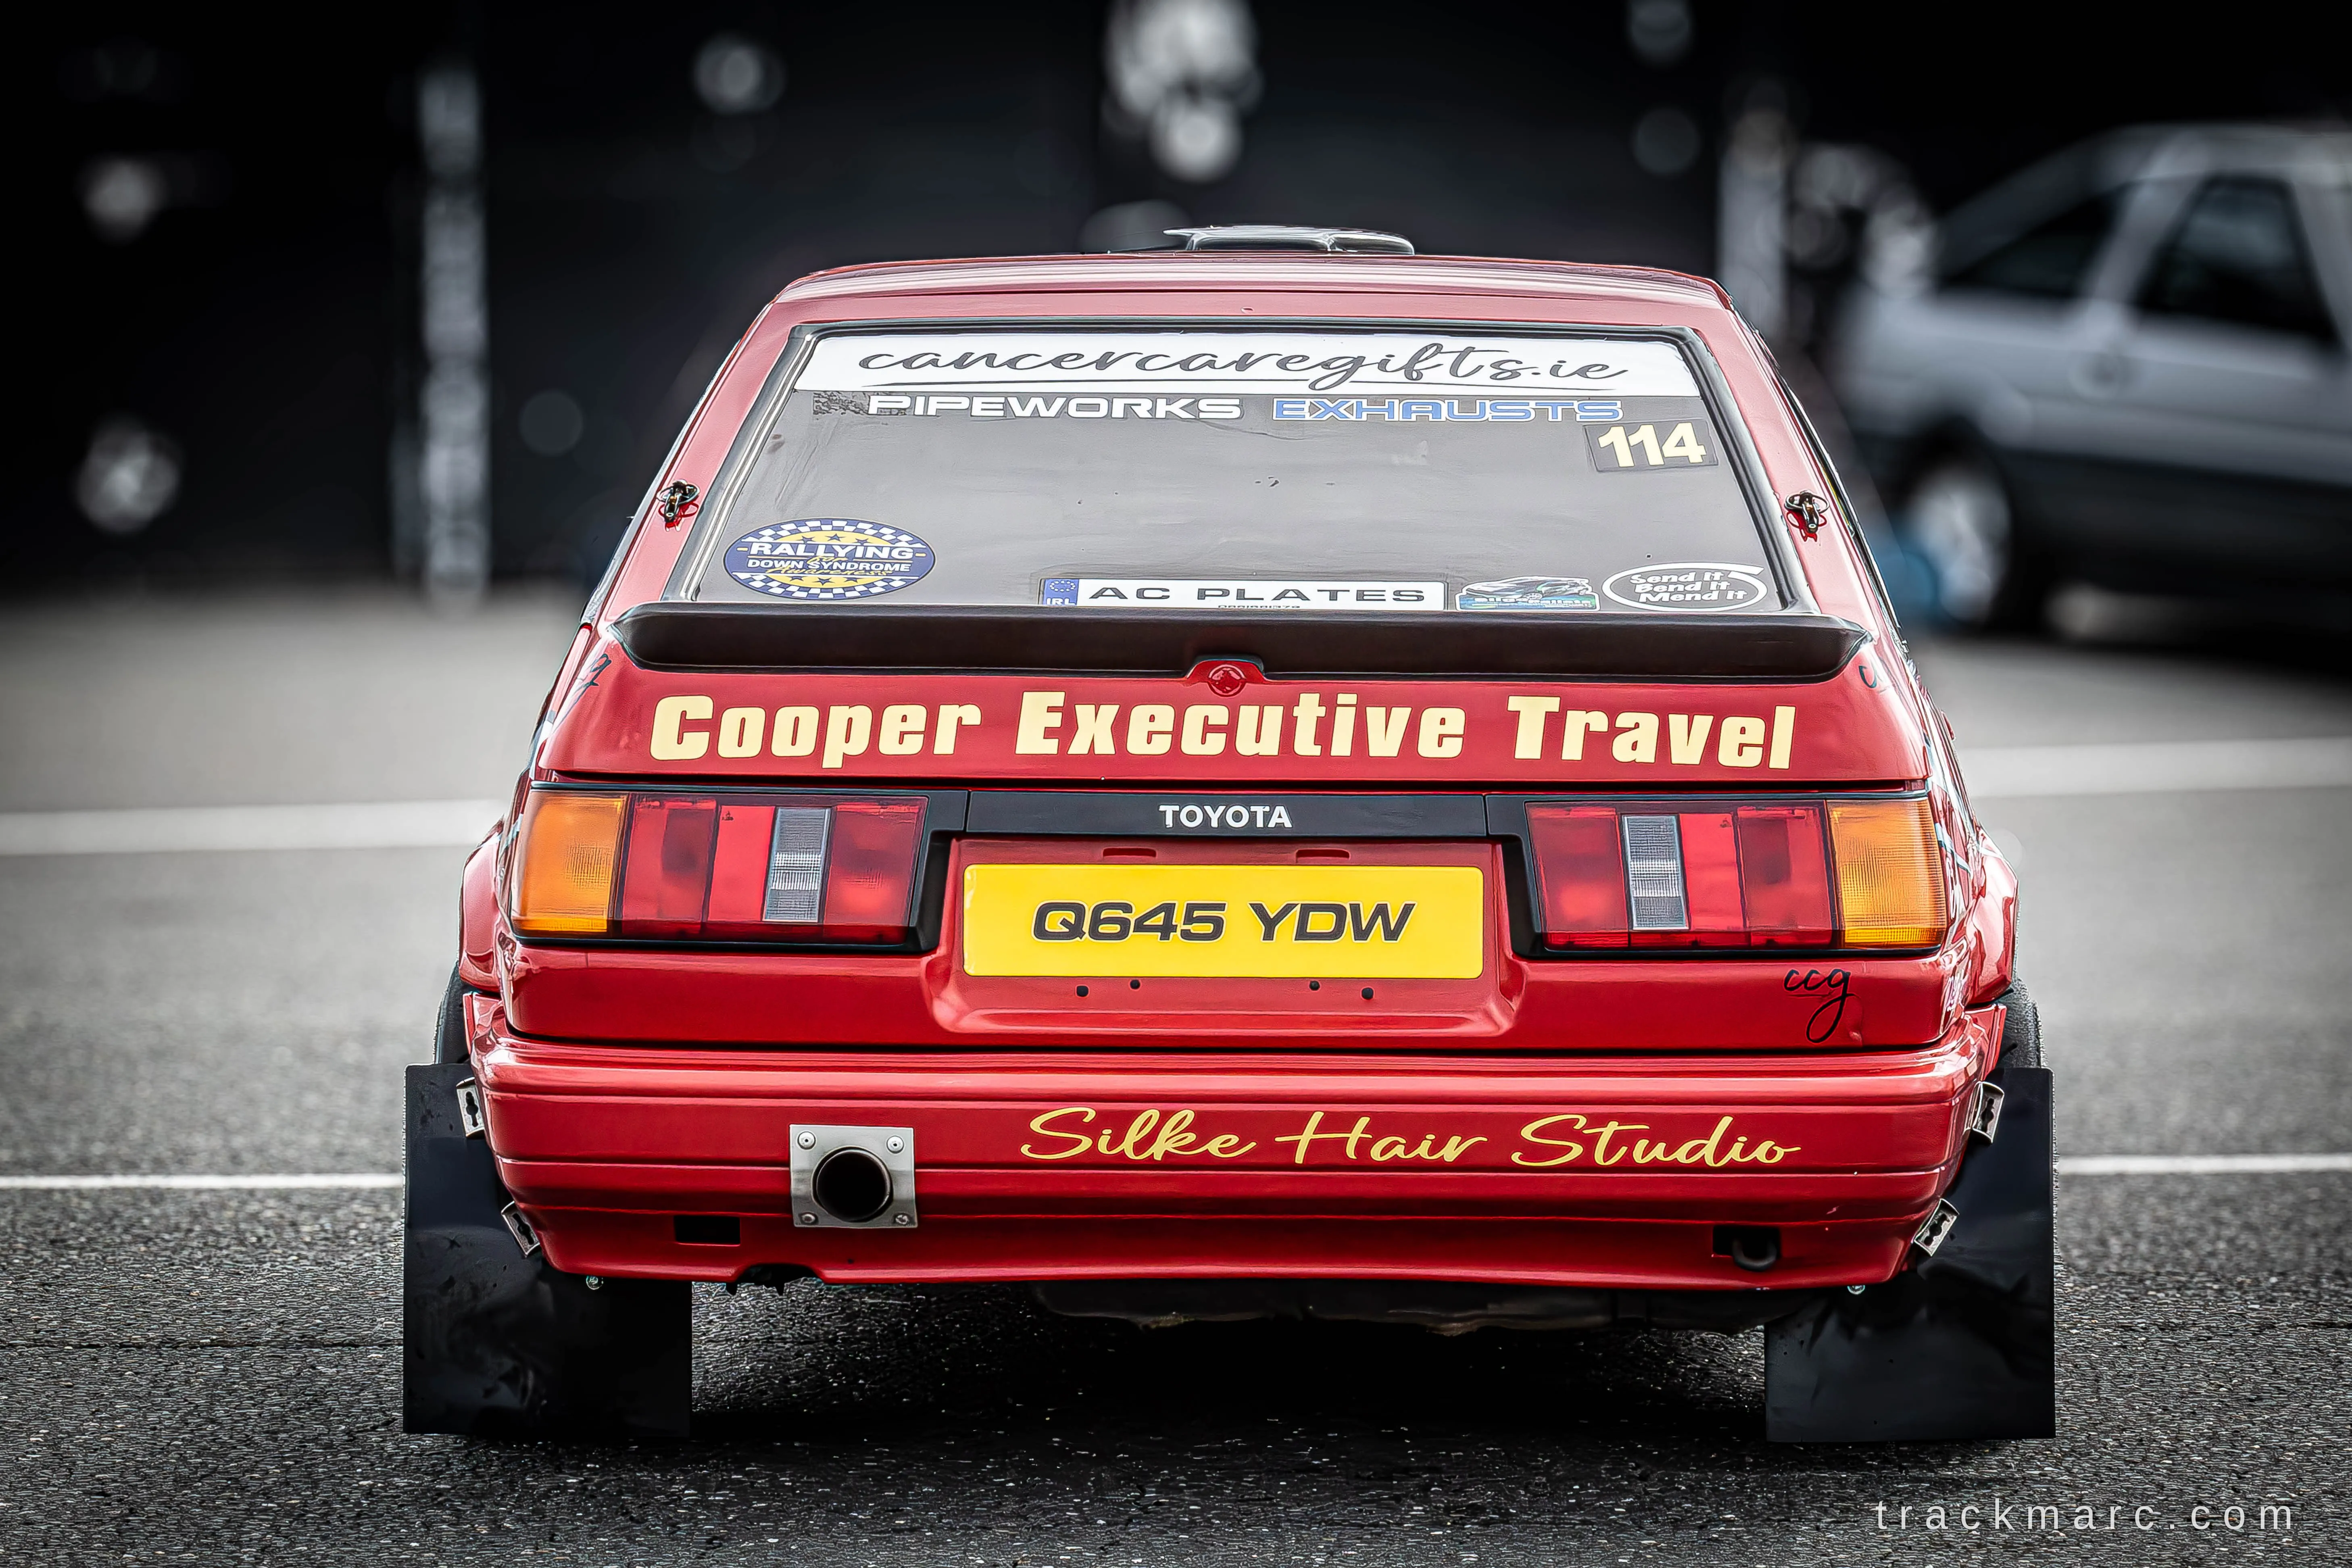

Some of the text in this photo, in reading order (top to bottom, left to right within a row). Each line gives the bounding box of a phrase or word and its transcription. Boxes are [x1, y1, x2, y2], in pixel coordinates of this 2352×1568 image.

[859, 343, 1628, 390] cancercaregifts.ie
[868, 394, 1624, 422] PIPEWORKS EXHAUSTS
[1599, 421, 1706, 468] 114
[749, 542, 914, 559] RALLYING
[747, 559, 911, 572] DOWN SYNDROME
[1630, 571, 1696, 584] Send
[1635, 581, 1702, 593] Bend
[1046, 597, 1076, 605] IRL
[1088, 587, 1424, 602] AC PLATES
[1639, 590, 1720, 603] Mend
[649, 690, 1797, 770] Cooper Executive Travel
[1159, 805, 1292, 829] TOYOTA
[1032, 901, 1417, 942] Q645 YDW
[1020, 1106, 1802, 1167] Silke Hair Studio
